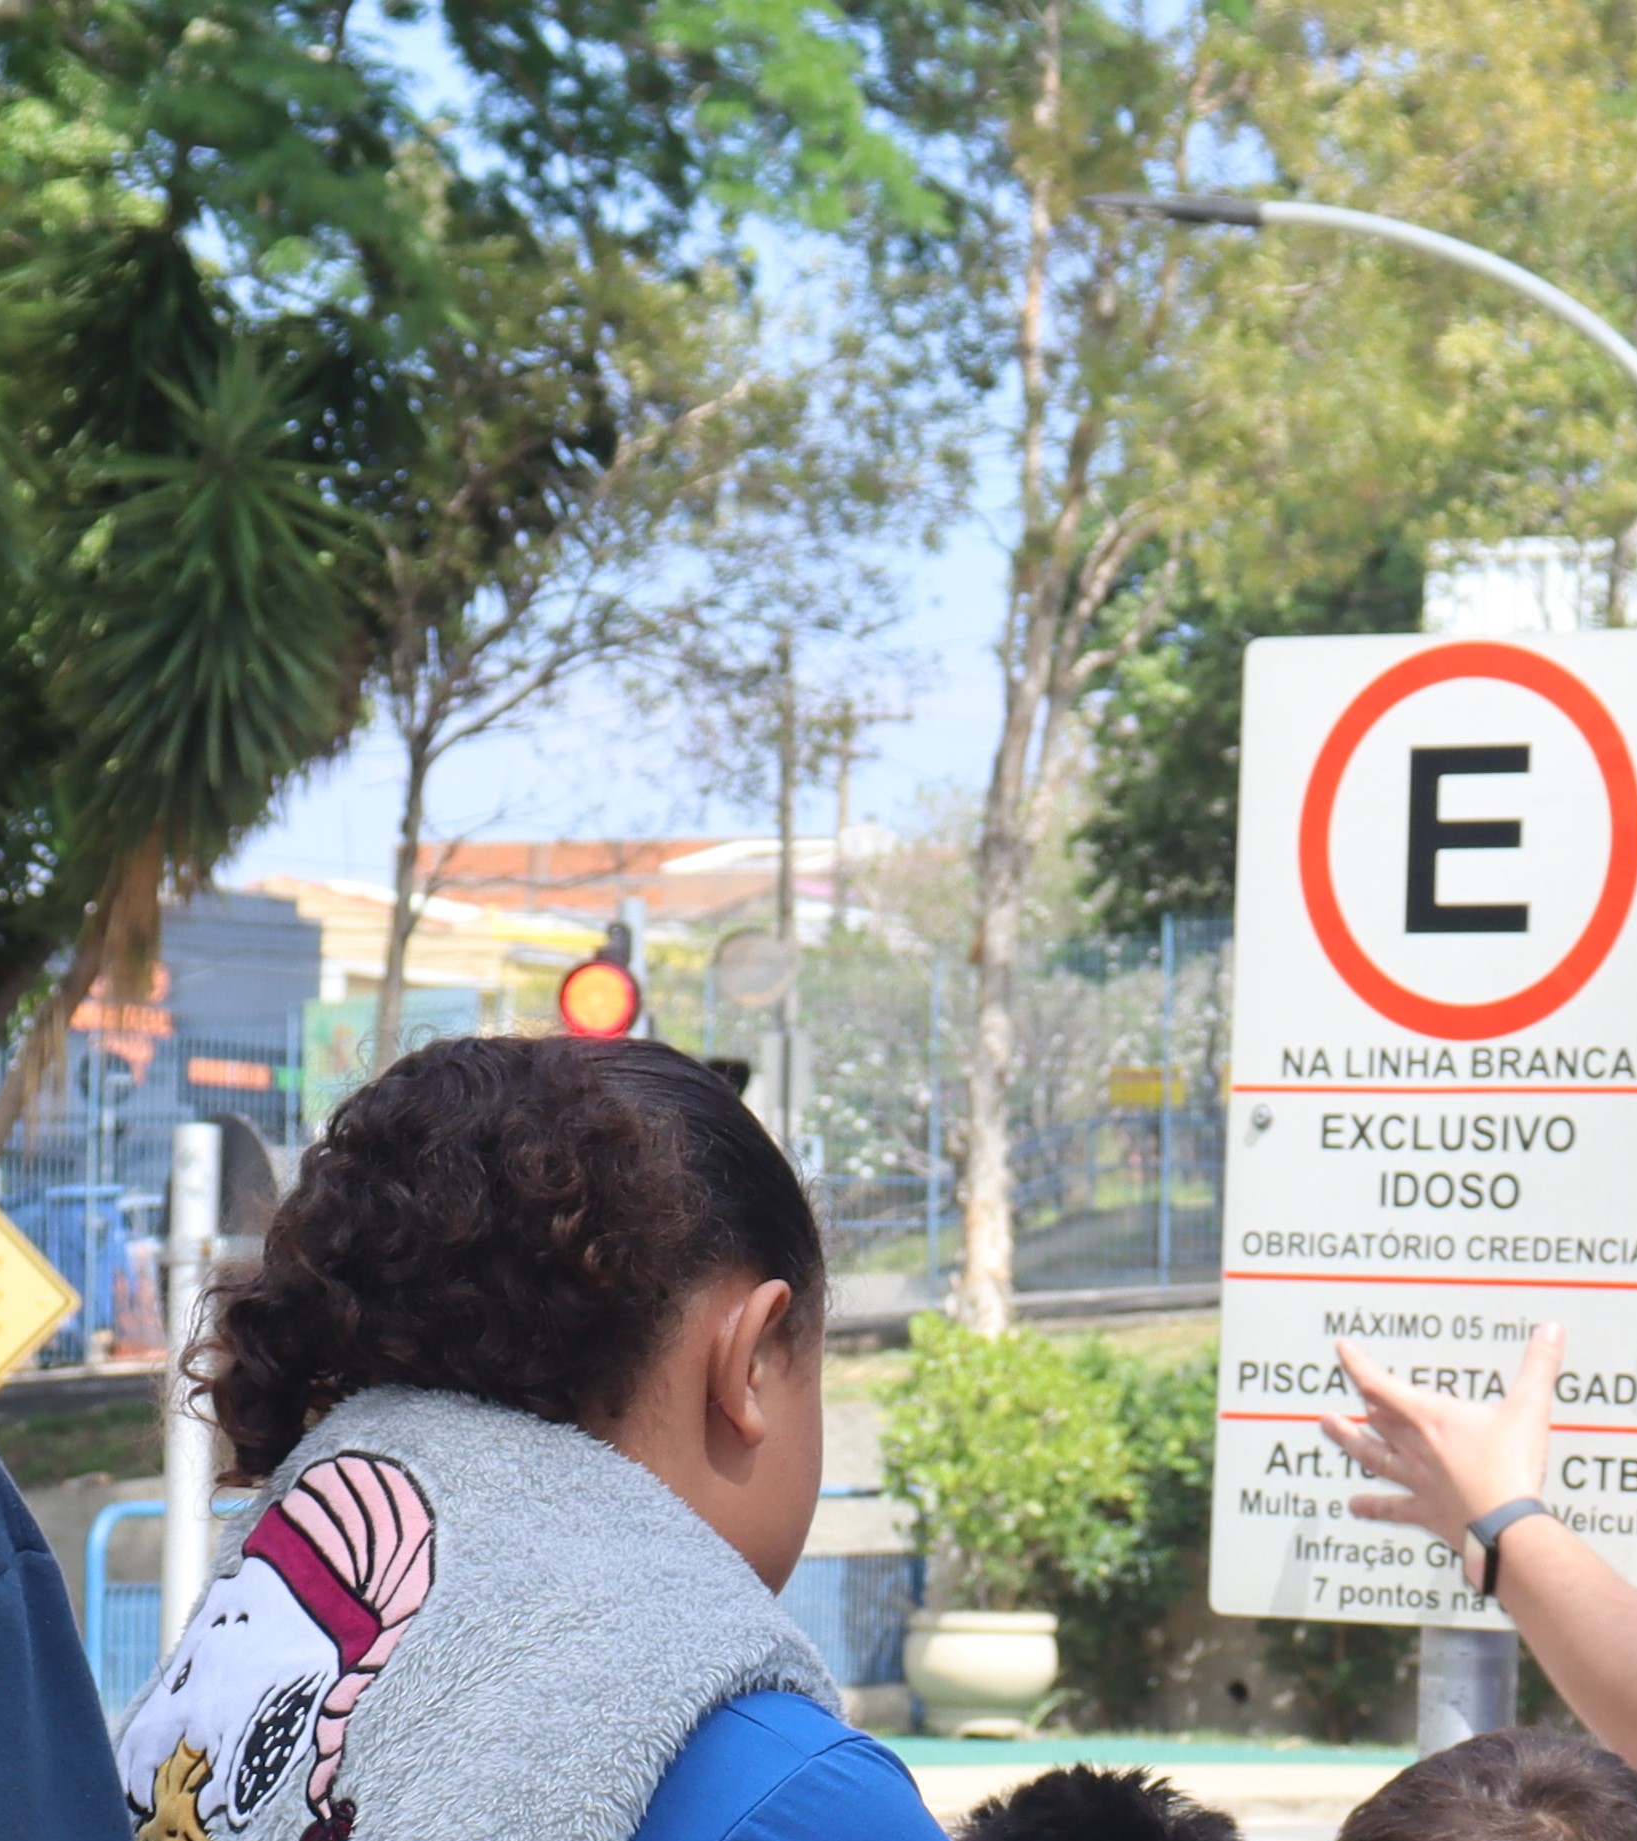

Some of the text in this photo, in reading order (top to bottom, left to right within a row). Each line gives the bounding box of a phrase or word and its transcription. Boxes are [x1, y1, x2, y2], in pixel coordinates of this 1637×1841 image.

[1405, 743, 1530, 933] E
[1281, 1048, 1636, 1079] NA LINHA BRANCA
[1320, 1114, 1576, 1151] EXCLUSIVO
[1380, 1172, 1520, 1208] IDOSO
[1242, 1229, 1455, 1262] OBRIGATÓRIO
[1324, 1307, 1442, 1339] MÁXIMO
[1452, 1315, 1483, 1340] 05
[1238, 1363, 1347, 1395] PISCA
[1240, 1488, 1316, 1517] Multa
[1329, 1499, 1343, 1518] e
[1295, 1535, 1414, 1571] Infração
[1314, 1577, 1328, 1602] 7
[1338, 1583, 1441, 1610] pontos
